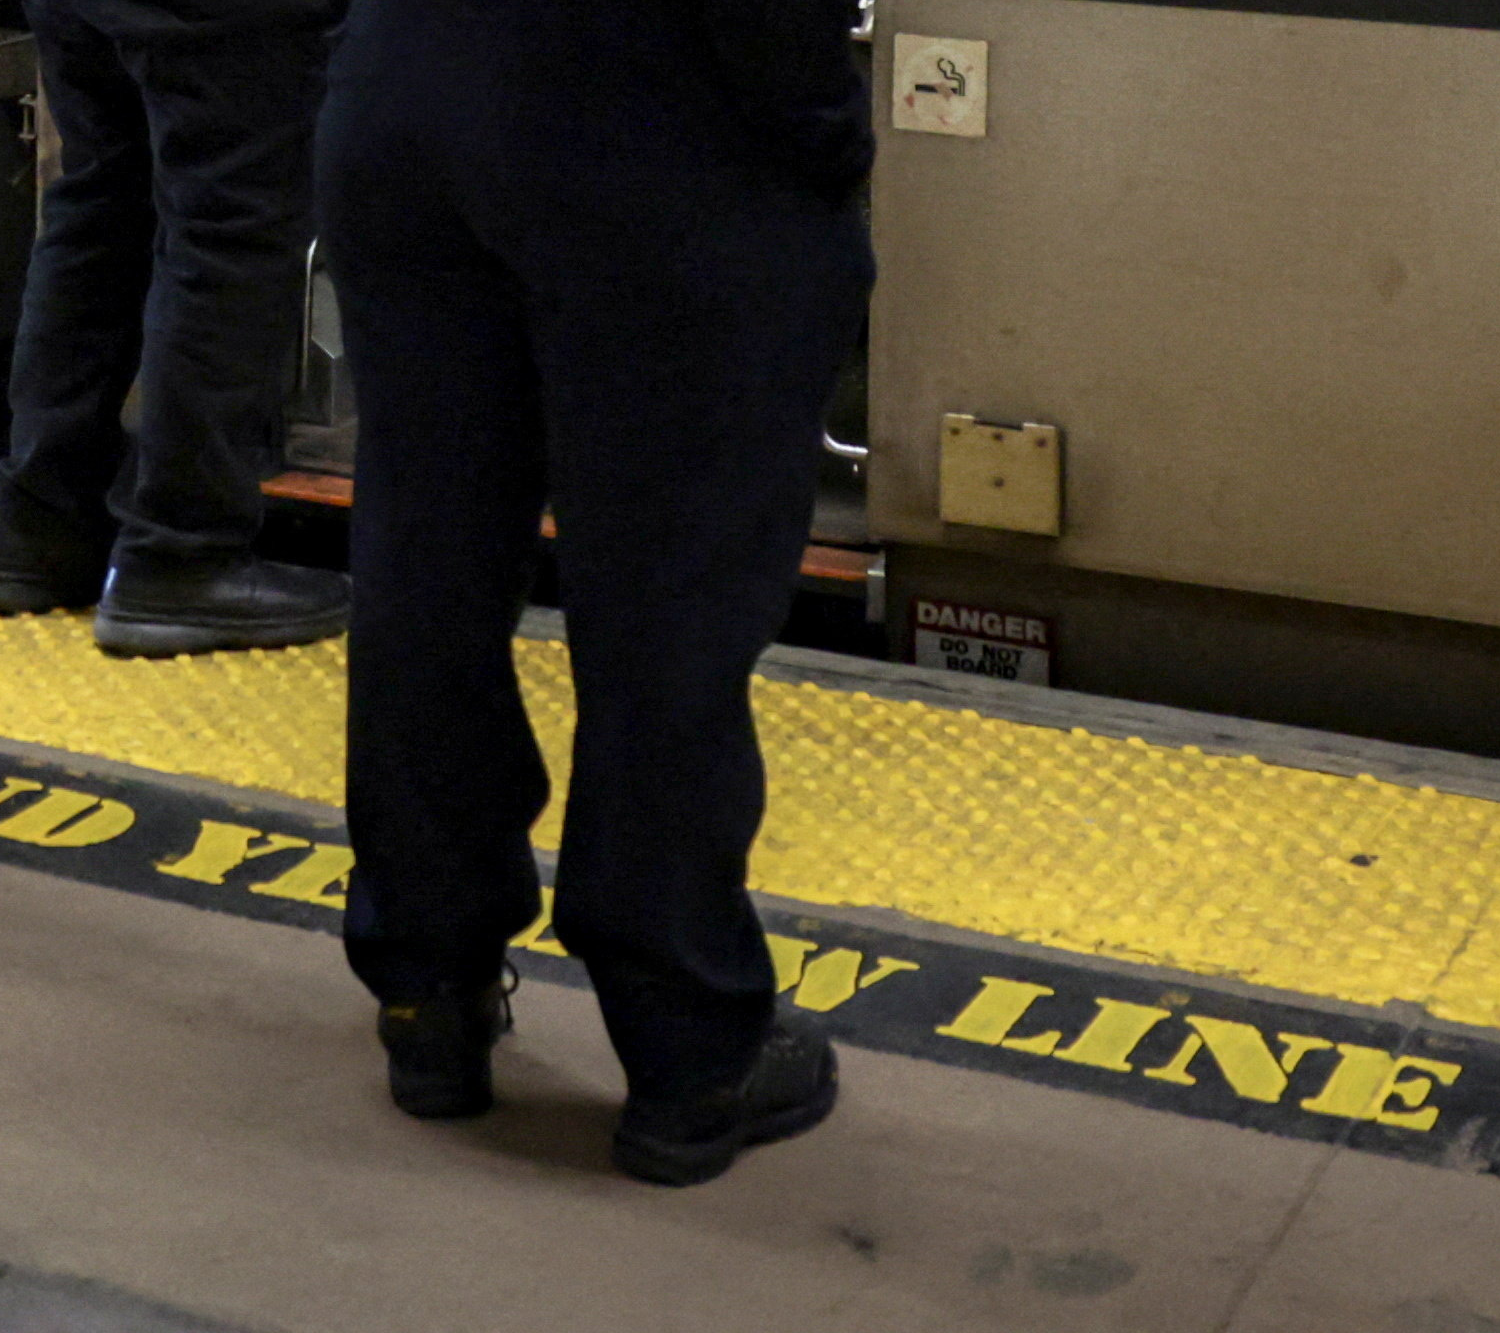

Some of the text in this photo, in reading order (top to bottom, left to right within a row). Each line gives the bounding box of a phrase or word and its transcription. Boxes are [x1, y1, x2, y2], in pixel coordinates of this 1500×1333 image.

[917, 601, 1048, 645] DANGER
[940, 637, 1023, 665] DO NOT
[946, 655, 1017, 681] BOARD
[935, 976, 1463, 1132] LINE
